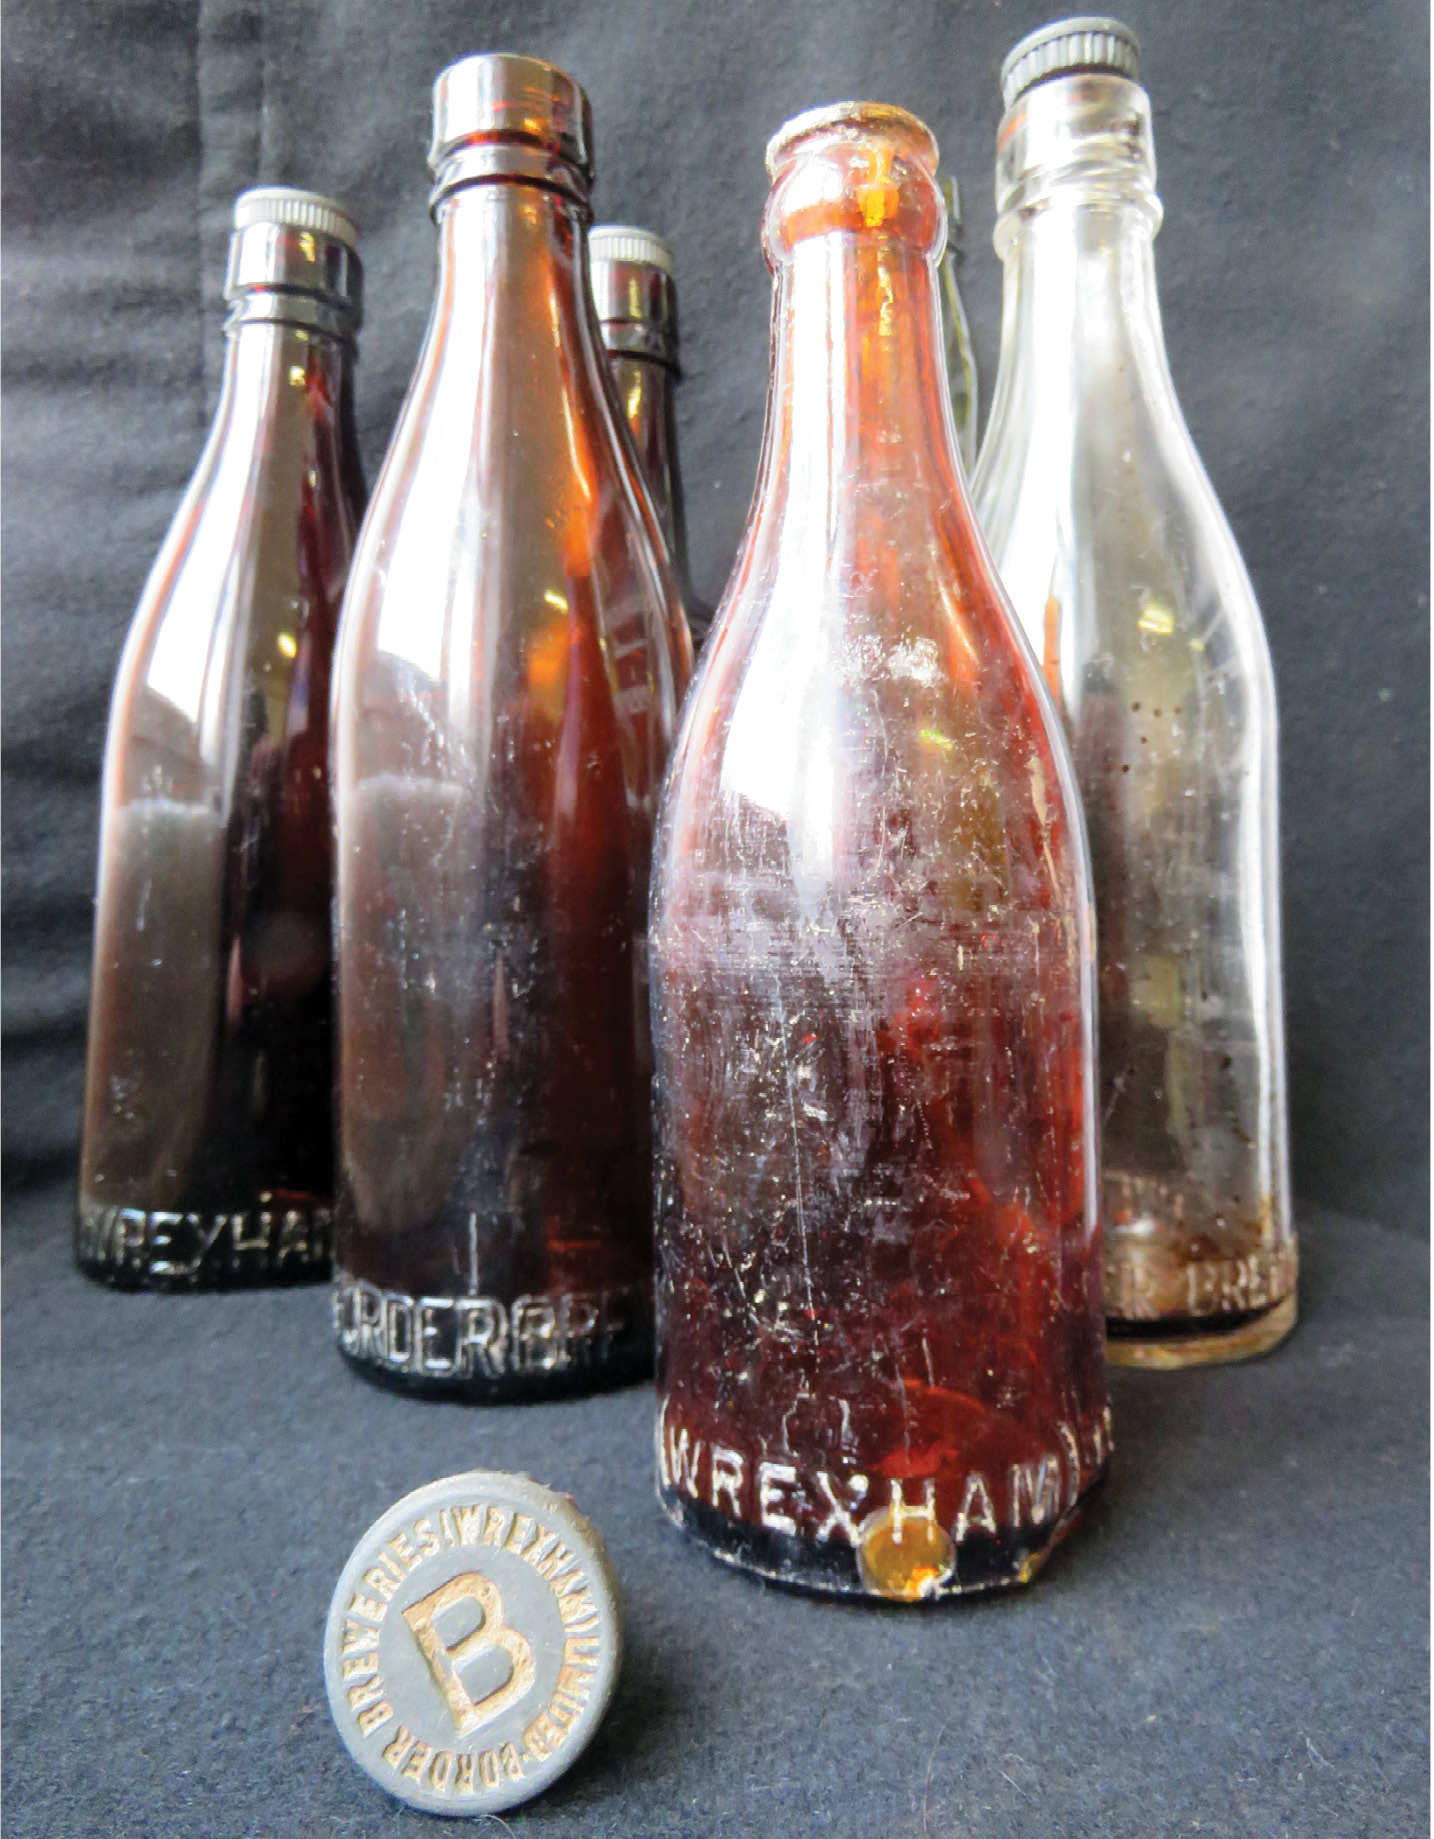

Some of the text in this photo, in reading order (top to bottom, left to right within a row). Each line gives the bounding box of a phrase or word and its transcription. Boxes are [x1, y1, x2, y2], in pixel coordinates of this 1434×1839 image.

[341, 1518, 441, 1739] BREWERIES
[402, 1570, 537, 1739] B
[380, 1723, 526, 1795] BORDER
